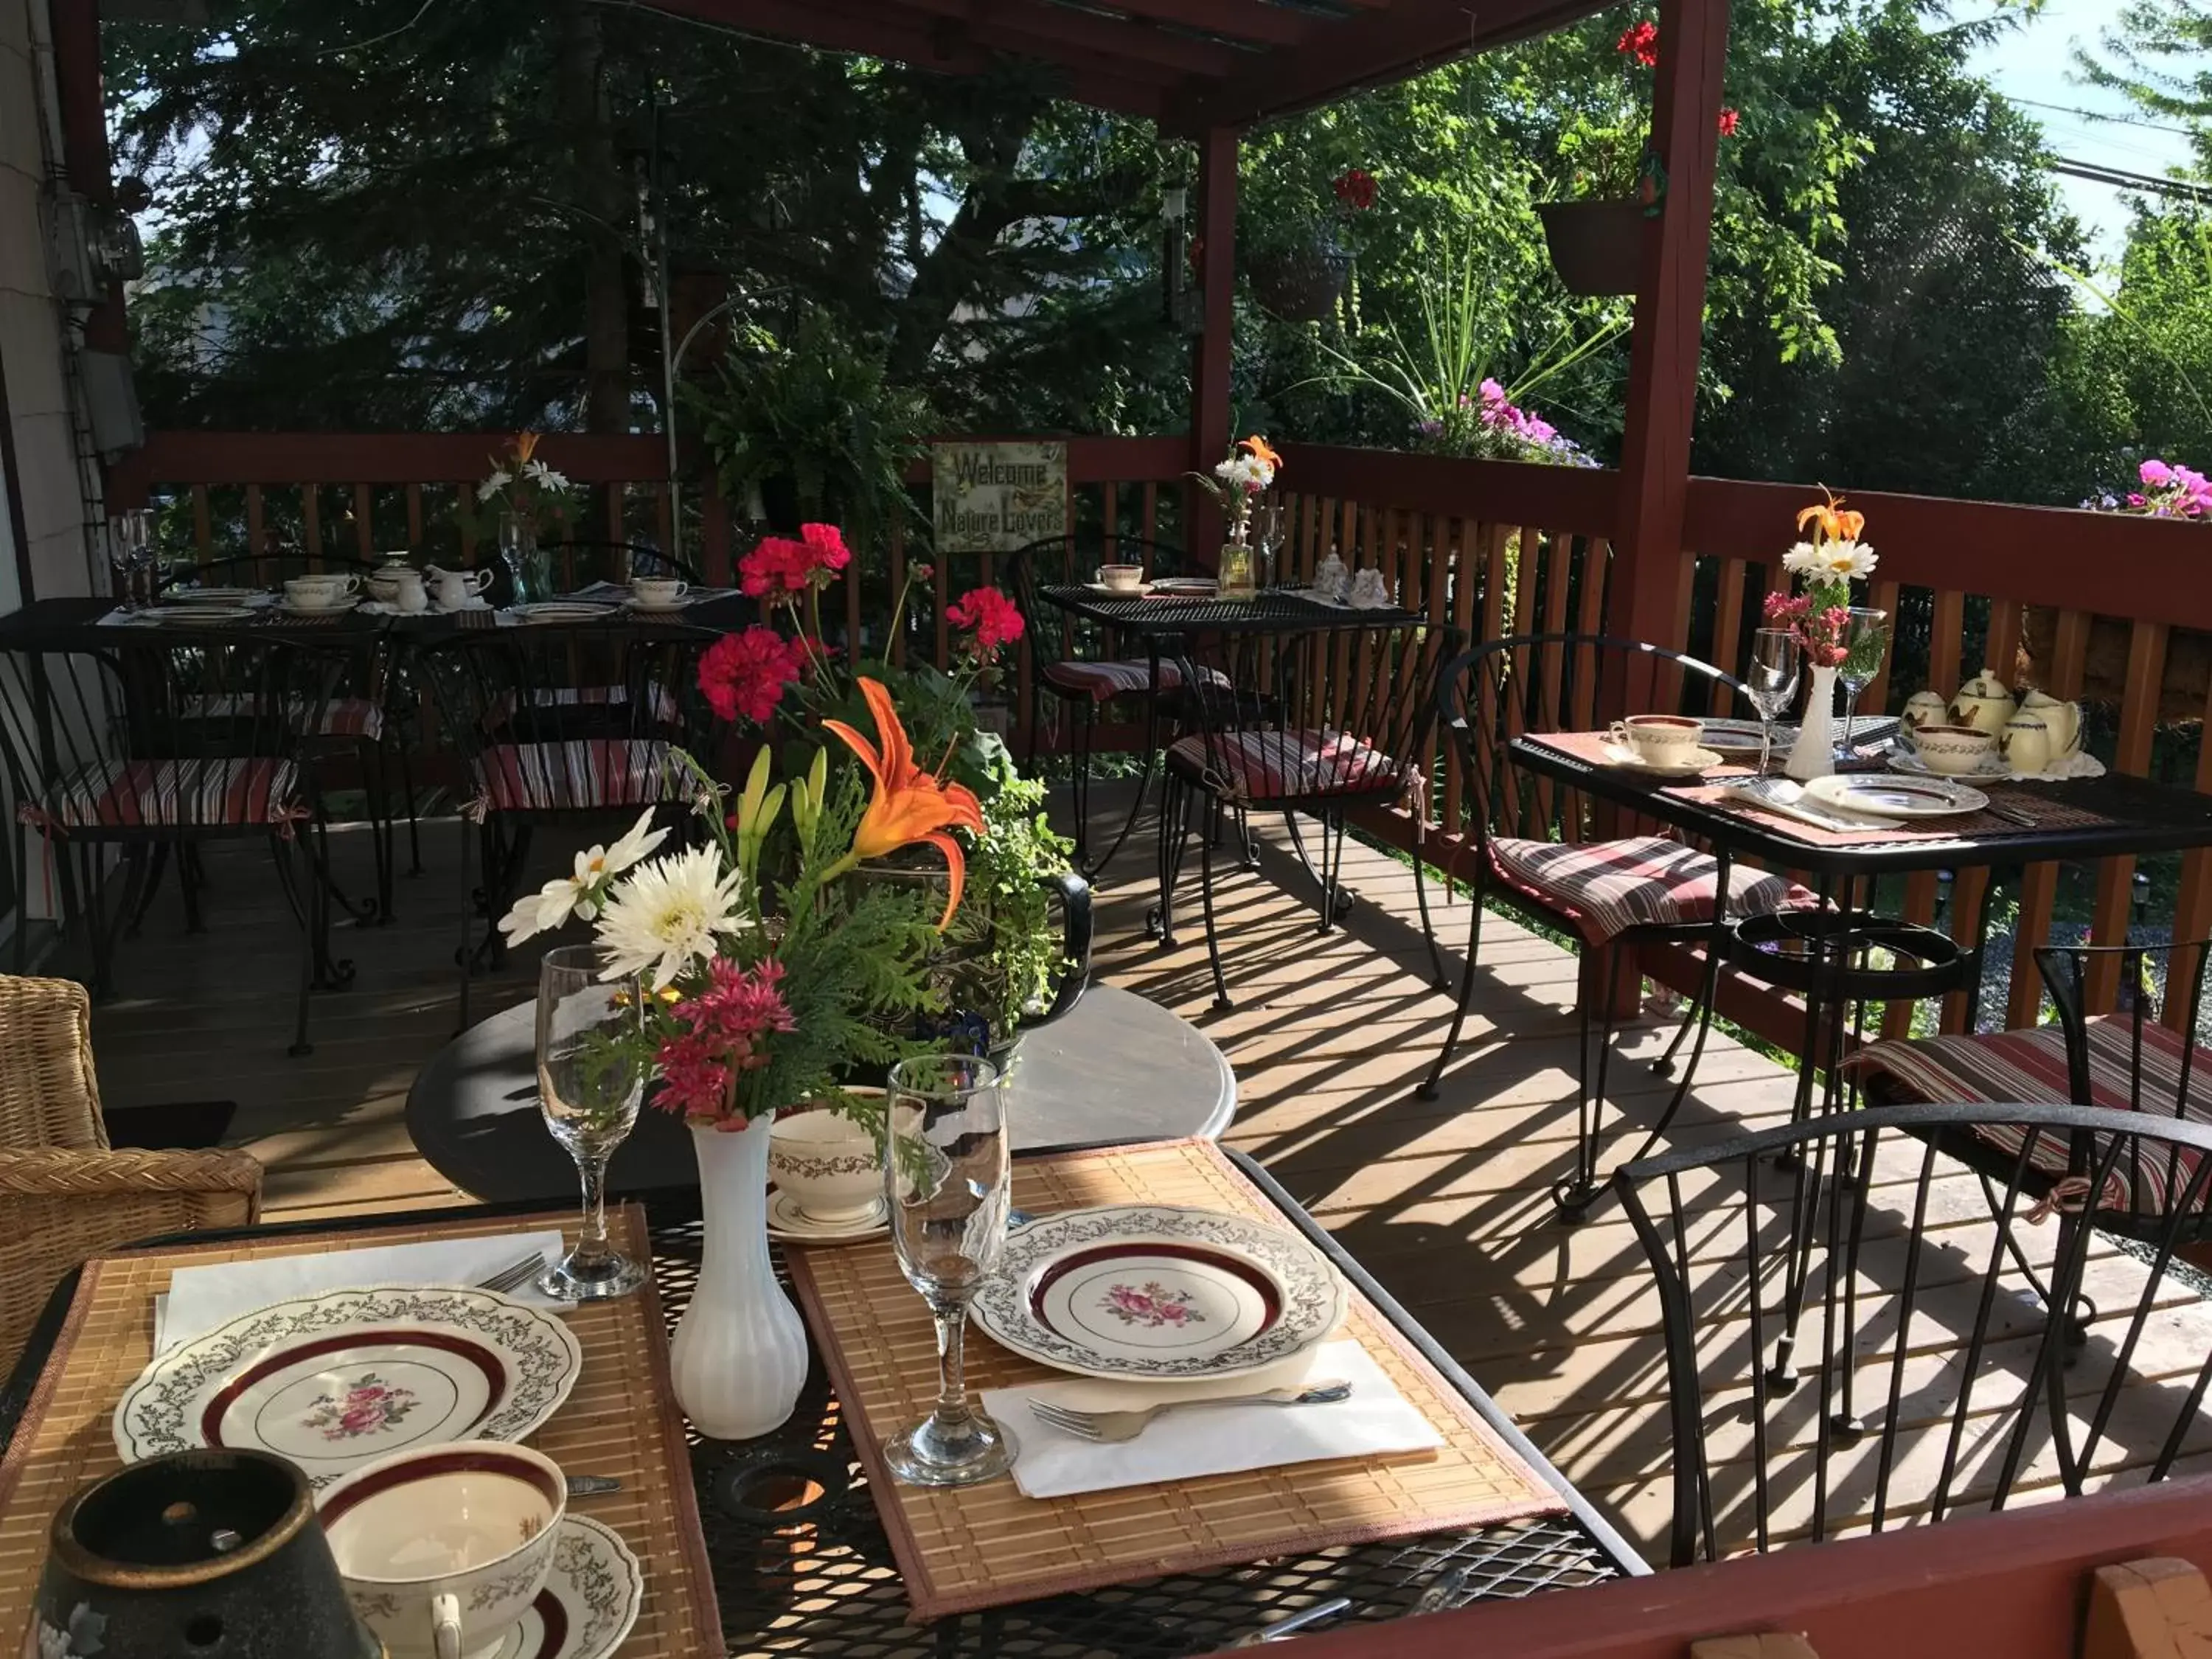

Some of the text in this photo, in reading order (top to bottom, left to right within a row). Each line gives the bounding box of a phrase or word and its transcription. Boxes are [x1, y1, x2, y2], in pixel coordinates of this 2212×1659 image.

[955, 452, 1047, 487] Welcome
[942, 495, 1062, 535] Nature Lovers
